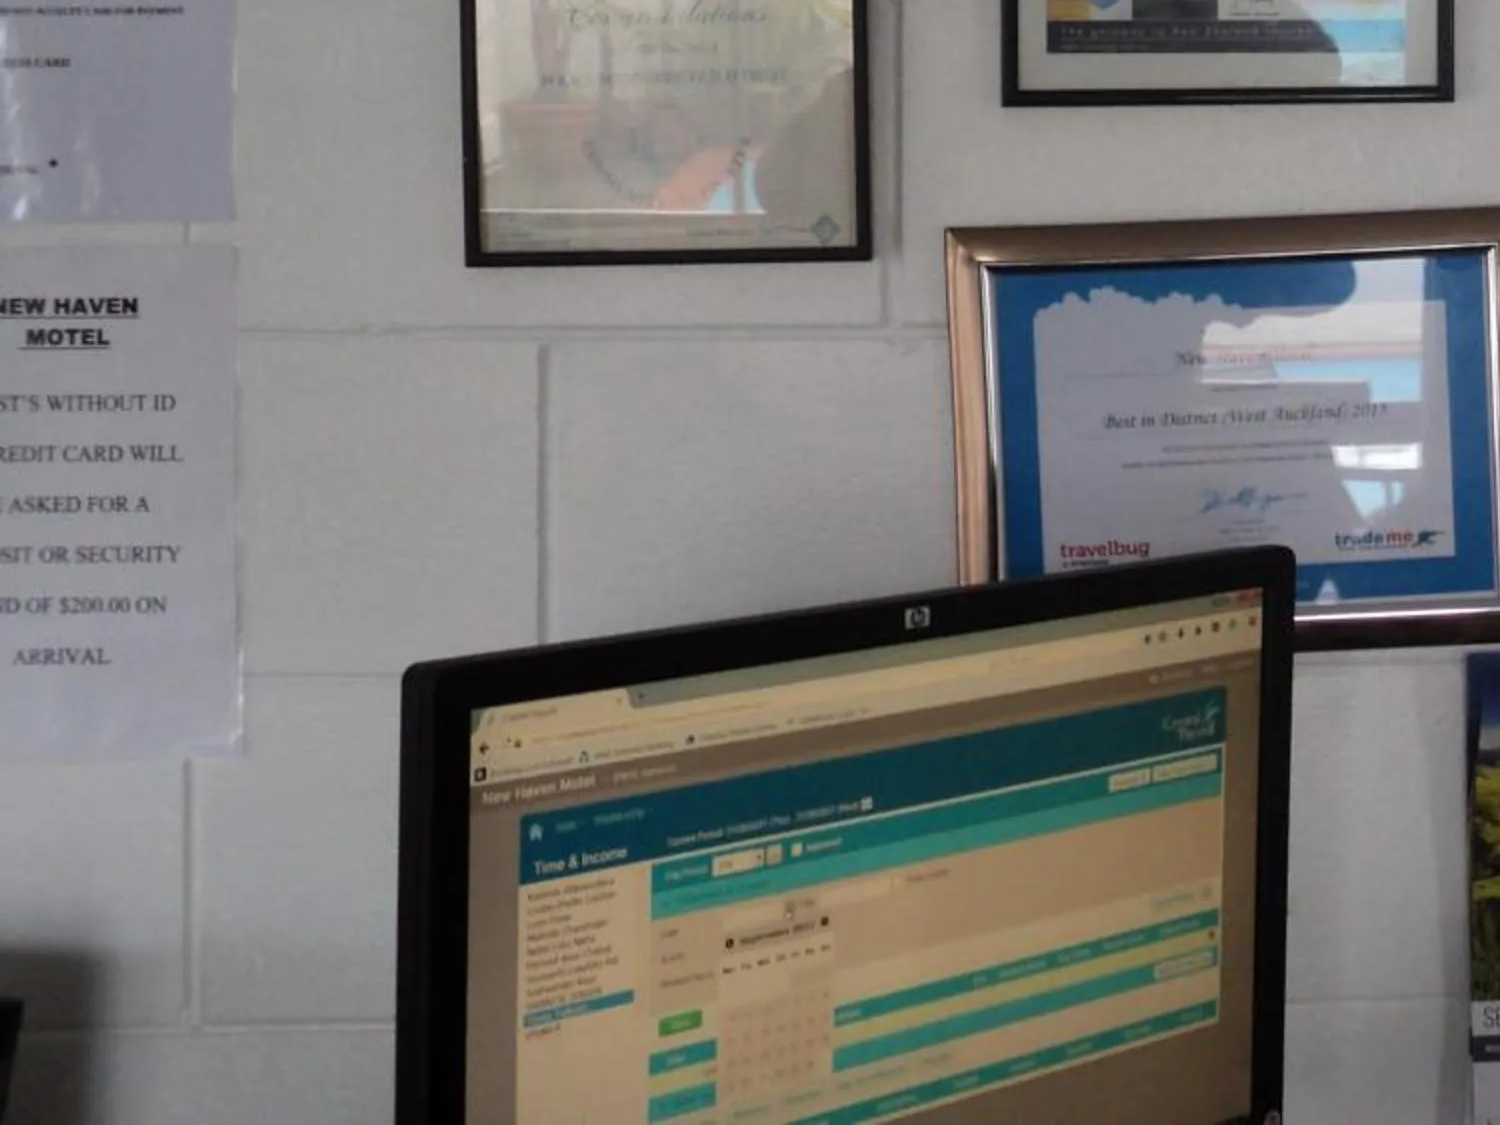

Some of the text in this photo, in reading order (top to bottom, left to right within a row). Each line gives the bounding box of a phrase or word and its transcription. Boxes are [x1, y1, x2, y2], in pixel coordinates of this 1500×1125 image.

[54, 298, 139, 315] HAVEN
[26, 328, 111, 346] MOTEL
[47, 394, 147, 412] WITHOUT
[154, 394, 177, 411] ID
[1104, 413, 1136, 430] Best
[1140, 412, 1156, 428] in
[1160, 408, 1219, 428] District
[62, 445, 124, 462] CARD
[130, 445, 184, 462] WILL
[9, 496, 151, 513] ASKED FOR A
[38, 546, 69, 563] OR
[76, 545, 181, 563] SECURITY
[1060, 538, 1150, 560] travelbug
[26, 597, 53, 614] OF
[59, 597, 131, 615] $200.00
[135, 597, 167, 614] ON
[13, 648, 111, 666] ARRIVAL
[482, 774, 596, 805] New Haven Motel
[533, 845, 628, 875] Time & Income
